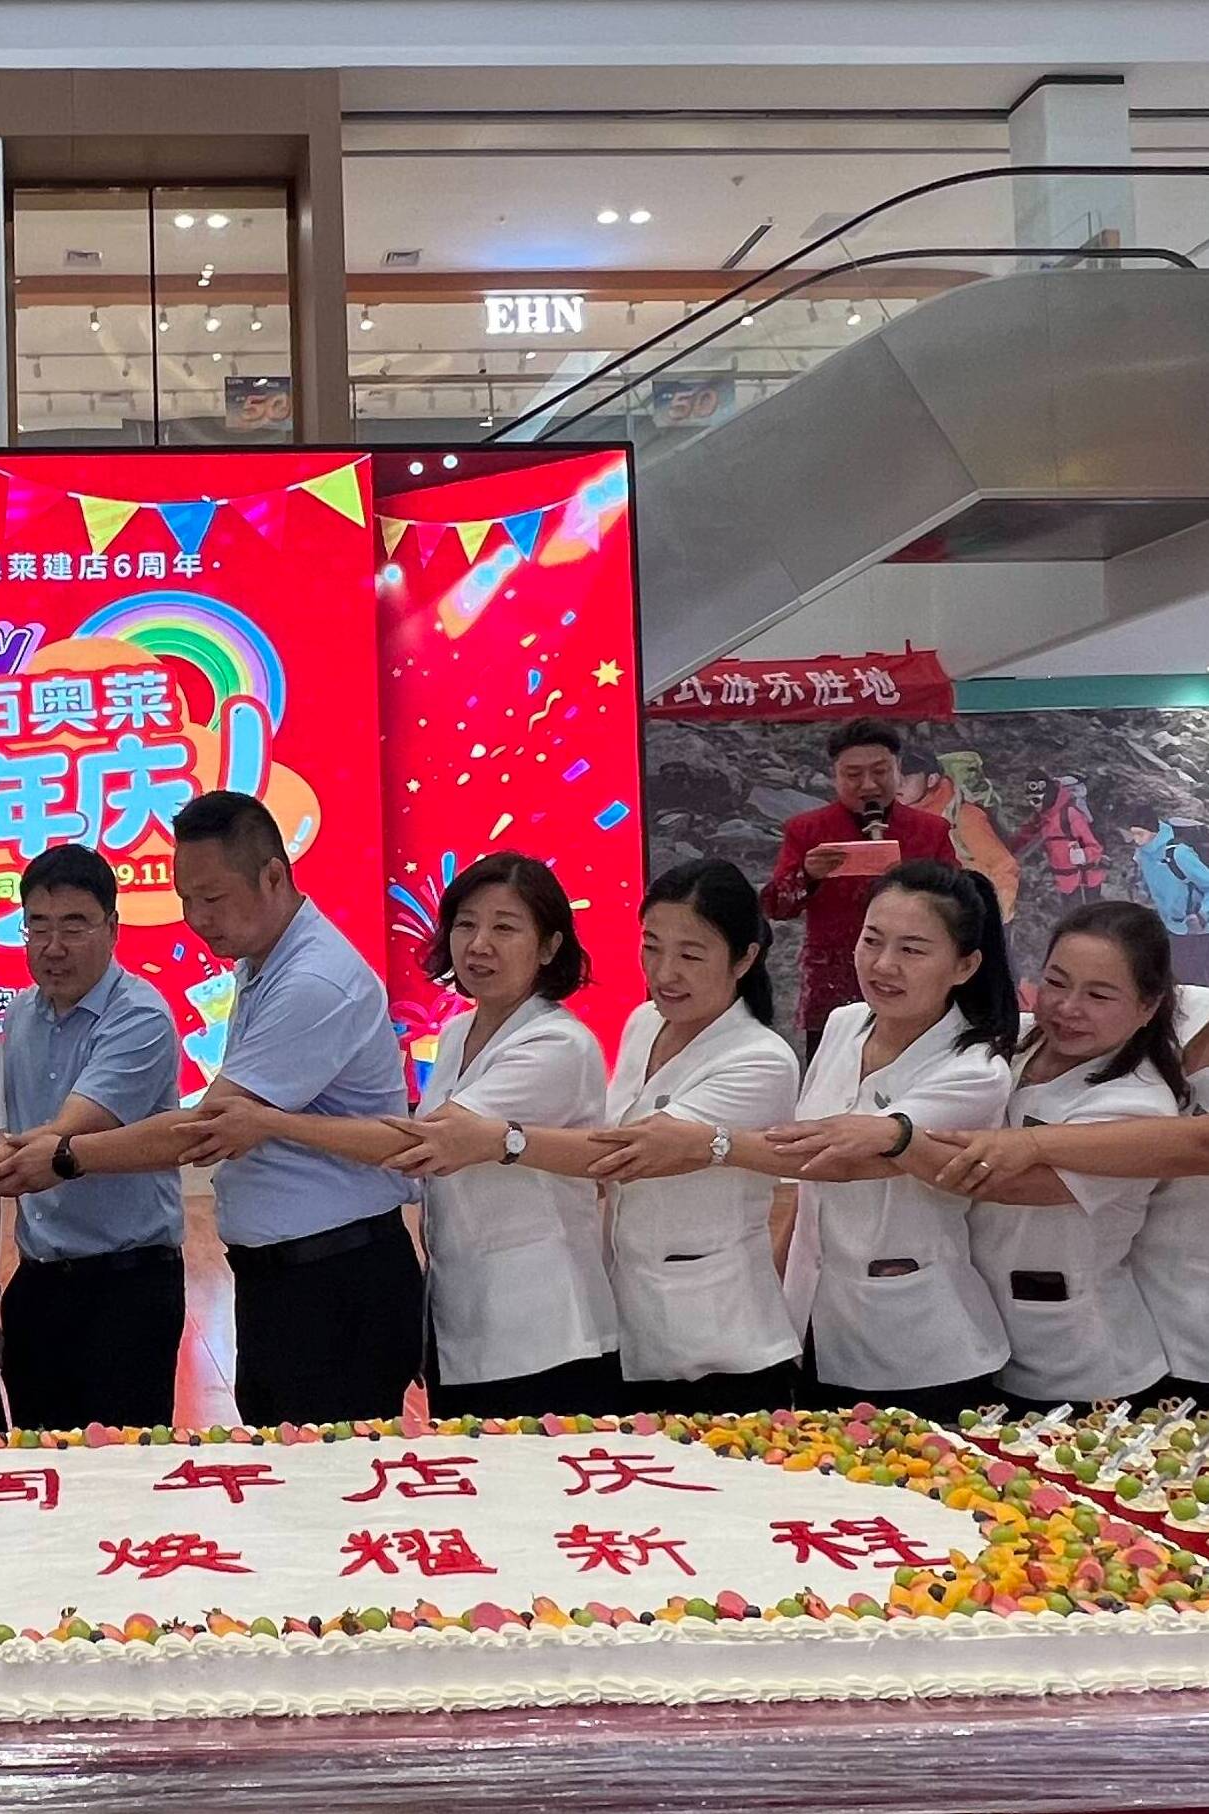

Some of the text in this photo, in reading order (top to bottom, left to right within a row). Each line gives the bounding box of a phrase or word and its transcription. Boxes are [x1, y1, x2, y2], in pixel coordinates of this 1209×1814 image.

[484, 296, 585, 334] EHN
[648, 667, 901, 706] 式游乐胜地
